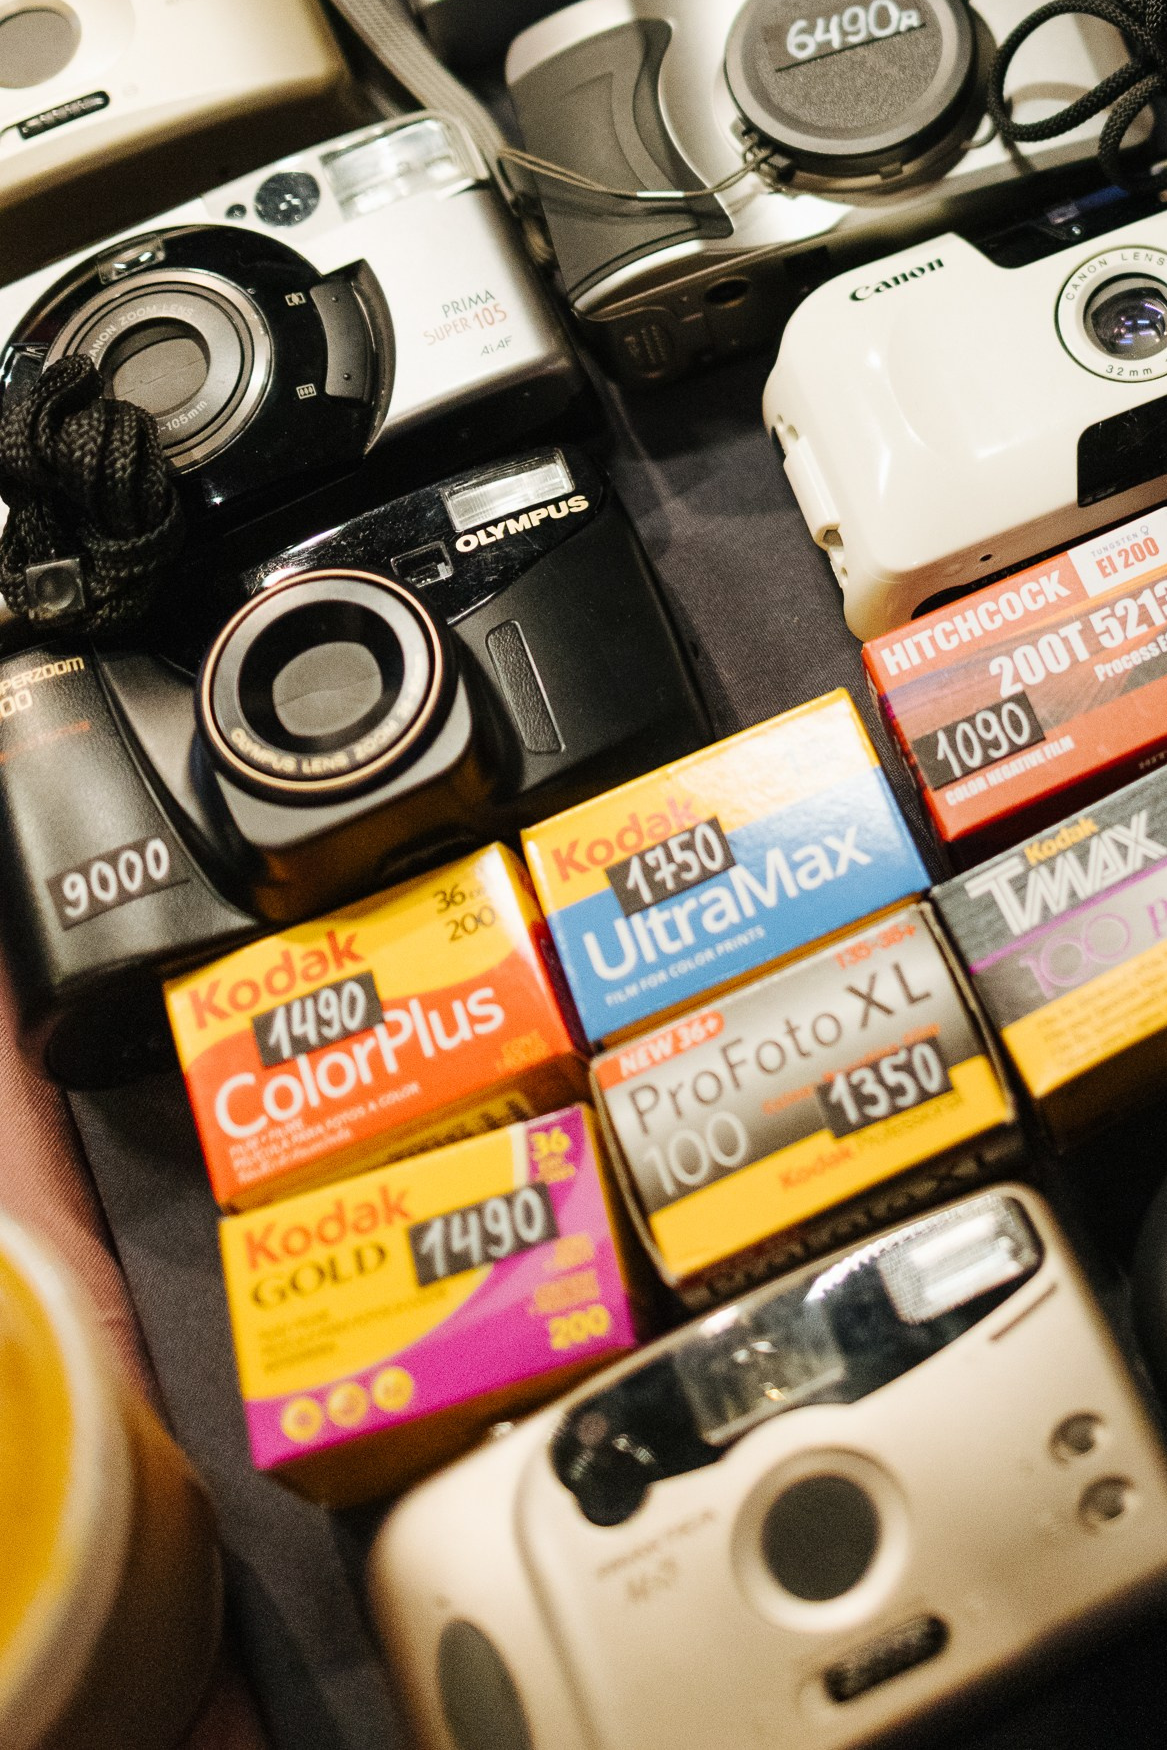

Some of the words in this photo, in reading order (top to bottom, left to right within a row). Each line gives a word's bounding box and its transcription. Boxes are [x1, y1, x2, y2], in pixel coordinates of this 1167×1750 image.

[440, 289, 497, 319] PRIMA
[849, 258, 944, 303] Canon
[1066, 258, 1108, 301] CANON
[1121, 252, 1165, 266] LENS
[88, 323, 117, 364] ANON
[117, 303, 158, 327] ZOOM
[160, 302, 195, 317] LENS
[423, 319, 473, 347] SUPER
[471, 302, 509, 330] 105
[1105, 365, 1153, 377] 32mm
[156, 399, 209, 434] -105mm
[455, 495, 591, 553] OLYMPUS
[1090, 530, 1139, 558] TUNGSTEN
[1117, 535, 1161, 569] 200
[879, 568, 1073, 678] HITCHCOCK
[0, 656, 85, 696] PERZOOM
[988, 620, 1094, 700] 200T
[0, 689, 33, 719] 00
[230, 727, 299, 774] OLYMPUS
[302, 754, 349, 775] LENS
[354, 720, 400, 760] ZOOM
[936, 700, 1032, 778] 1090
[944, 774, 988, 807] COLOR
[987, 749, 1047, 789] NEGATIVE
[1046, 735, 1076, 762] FILM
[550, 793, 703, 884] Kodak
[625, 820, 724, 906] 1750
[1023, 815, 1100, 868] Kodak
[62, 837, 170, 917] 9000
[433, 883, 466, 915] 36
[581, 825, 873, 982] UltraMax
[445, 906, 497, 944] 200
[1018, 911, 1131, 1002] 100
[188, 929, 366, 1030] Kodak
[604, 981, 640, 1008] FILM
[638, 971, 668, 992] FOR
[668, 950, 715, 981] COLOR
[714, 925, 766, 958] PRINTS
[268, 980, 367, 1059] 1490
[619, 1039, 675, 1077] NEW
[677, 1015, 723, 1046] 36+
[627, 1013, 843, 1136] ProFoto
[845, 961, 932, 1031] XL
[214, 986, 505, 1140] ColorPlus
[828, 1041, 942, 1124] 1350
[530, 1126, 572, 1159] 36
[643, 1109, 749, 1196] 100
[243, 1184, 413, 1273] Kodak
[420, 1184, 547, 1278] 1490
[250, 1241, 388, 1311] GOLD
[548, 1303, 613, 1351] 200
